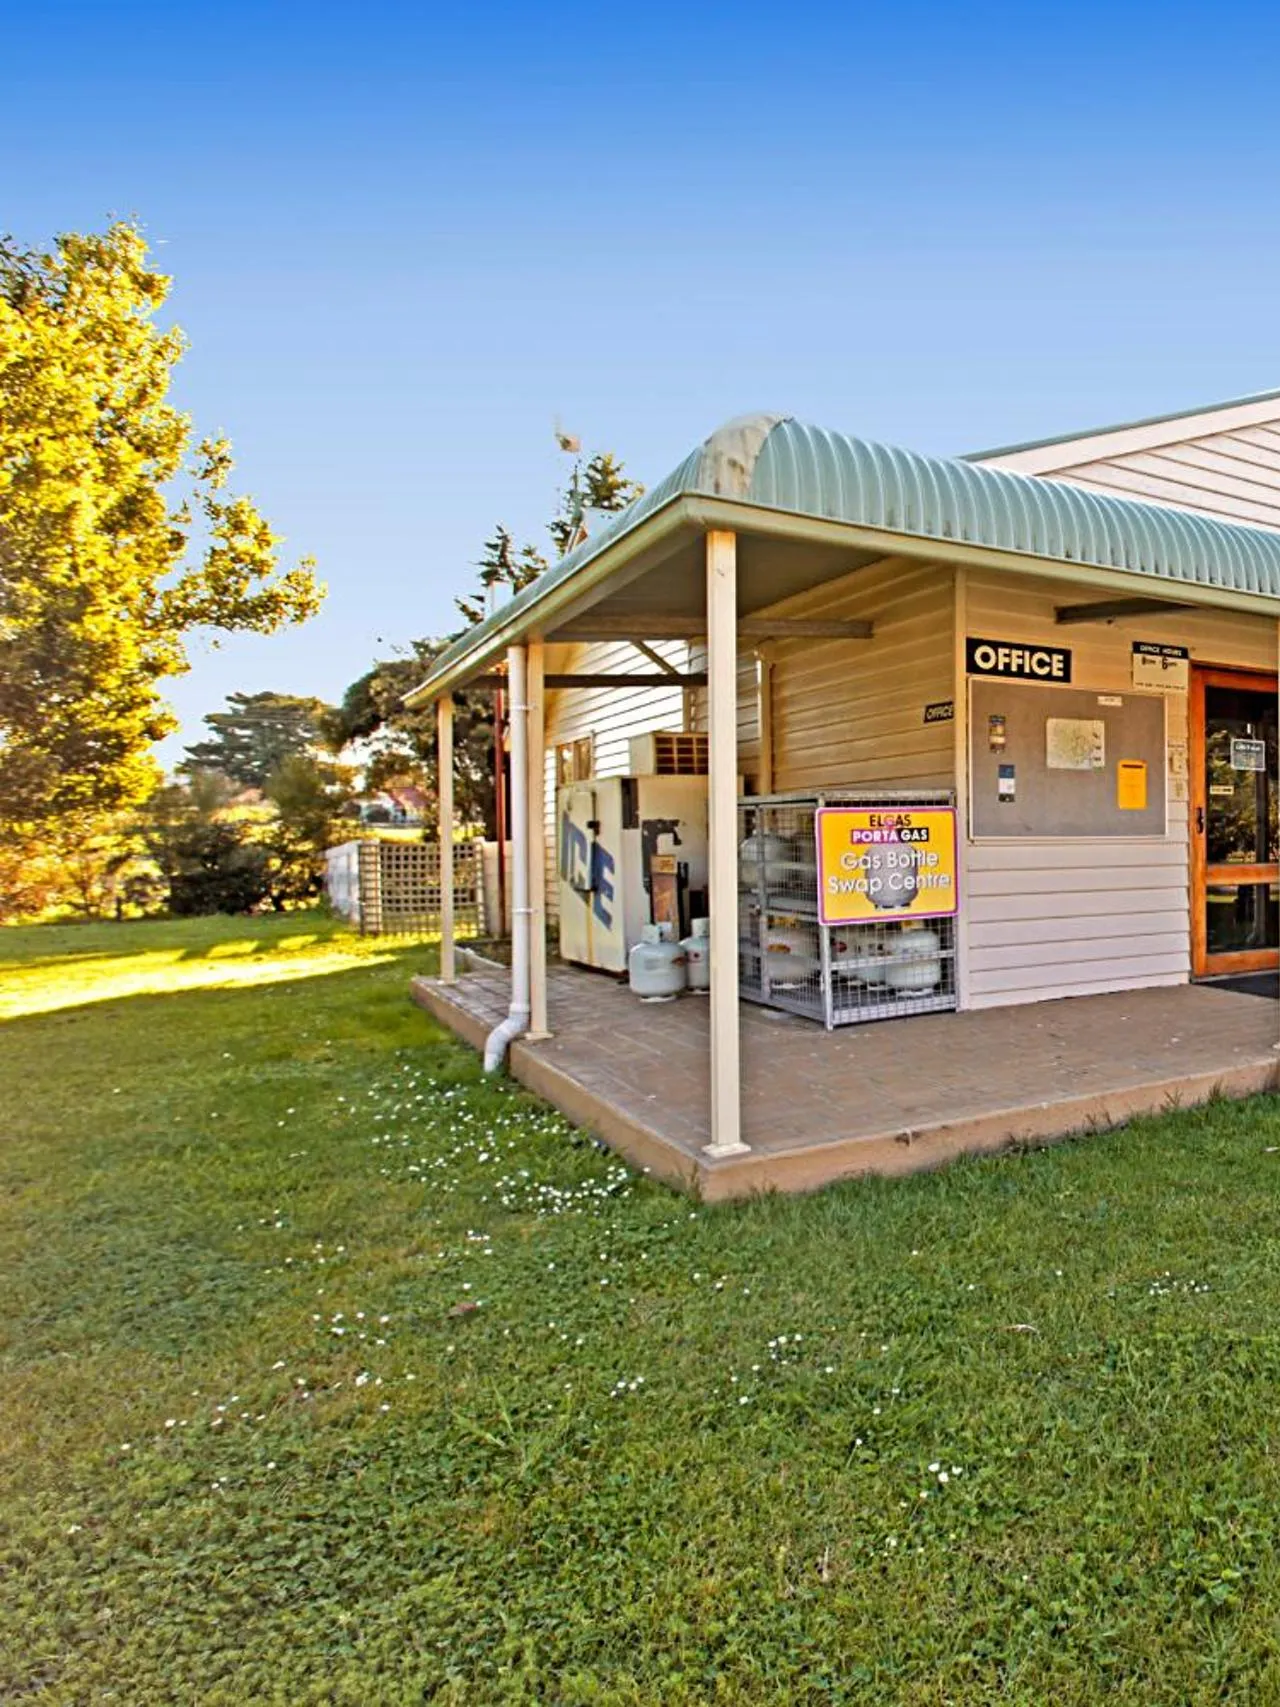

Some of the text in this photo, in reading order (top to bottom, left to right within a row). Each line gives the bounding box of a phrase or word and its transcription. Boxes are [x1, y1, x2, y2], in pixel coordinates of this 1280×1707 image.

[1139, 645, 1160, 654] OFFICE
[973, 644, 1065, 677] OFFICE
[926, 703, 953, 720] OFFICE
[869, 814, 912, 827] ELGAS
[840, 850, 939, 870] Gas Bottle
[560, 810, 616, 932] ICE
[828, 871, 951, 895] Swap Centre
